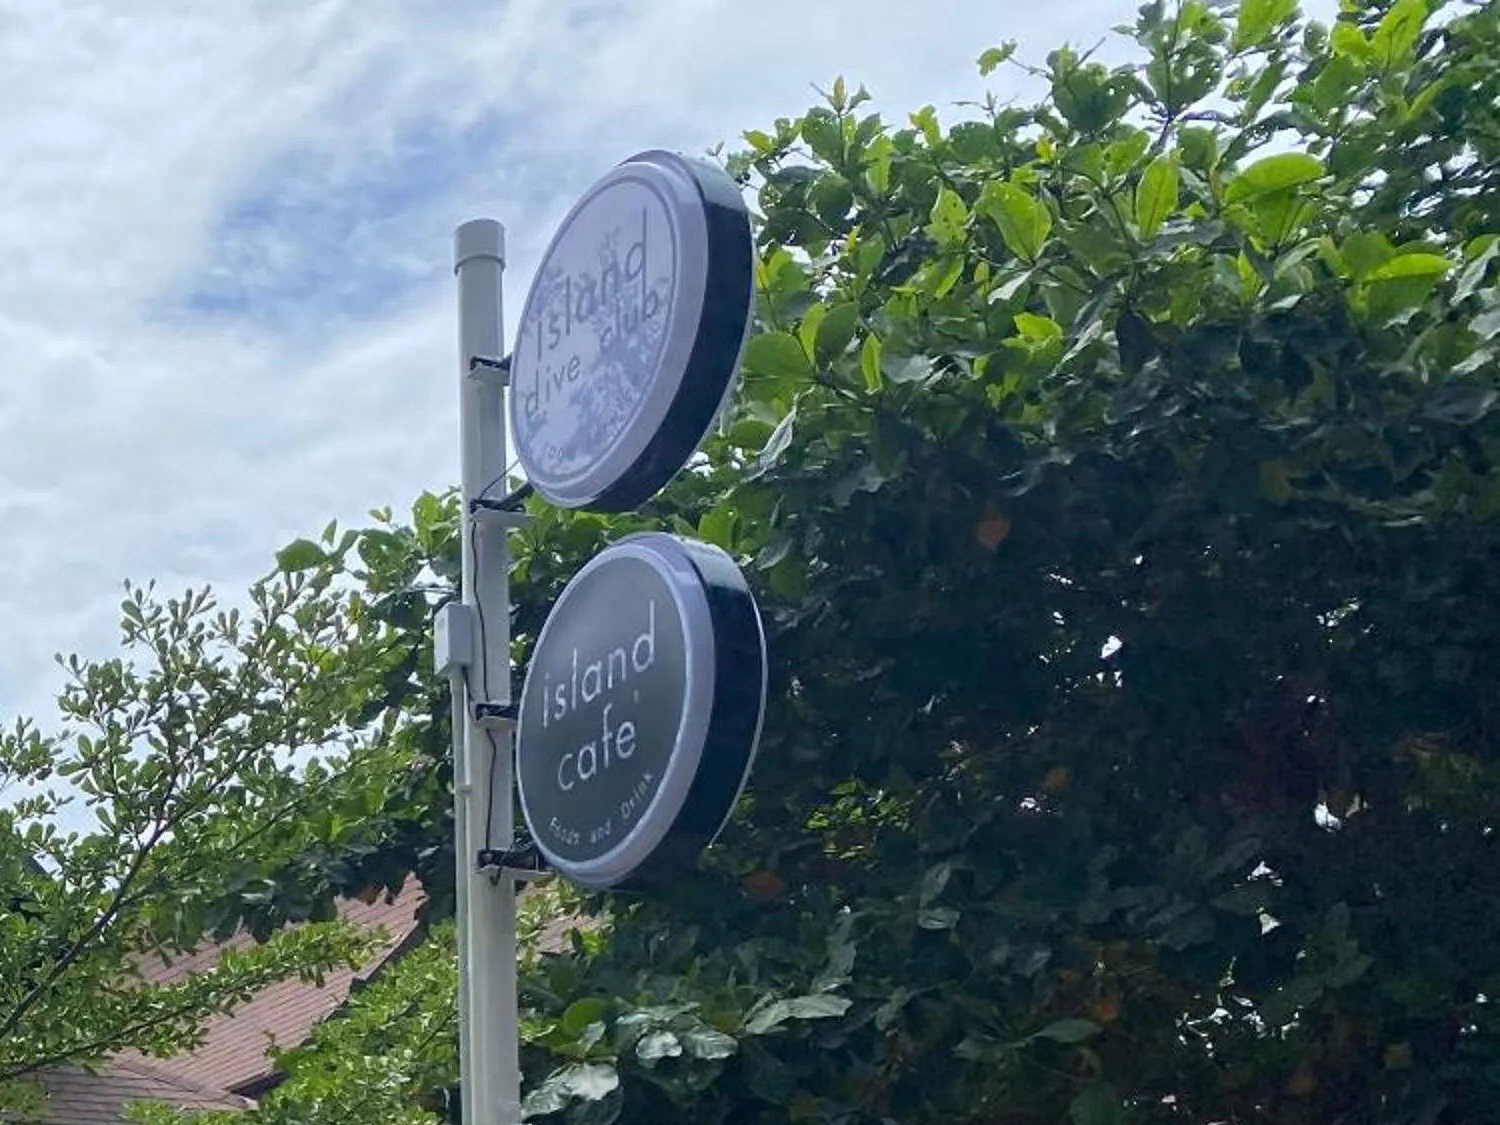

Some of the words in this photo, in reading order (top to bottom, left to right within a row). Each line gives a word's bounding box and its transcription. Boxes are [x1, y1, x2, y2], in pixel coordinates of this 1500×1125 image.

[536, 206, 648, 361] island
[524, 353, 581, 415] dive
[542, 599, 656, 729] island
[557, 702, 637, 792] cafe
